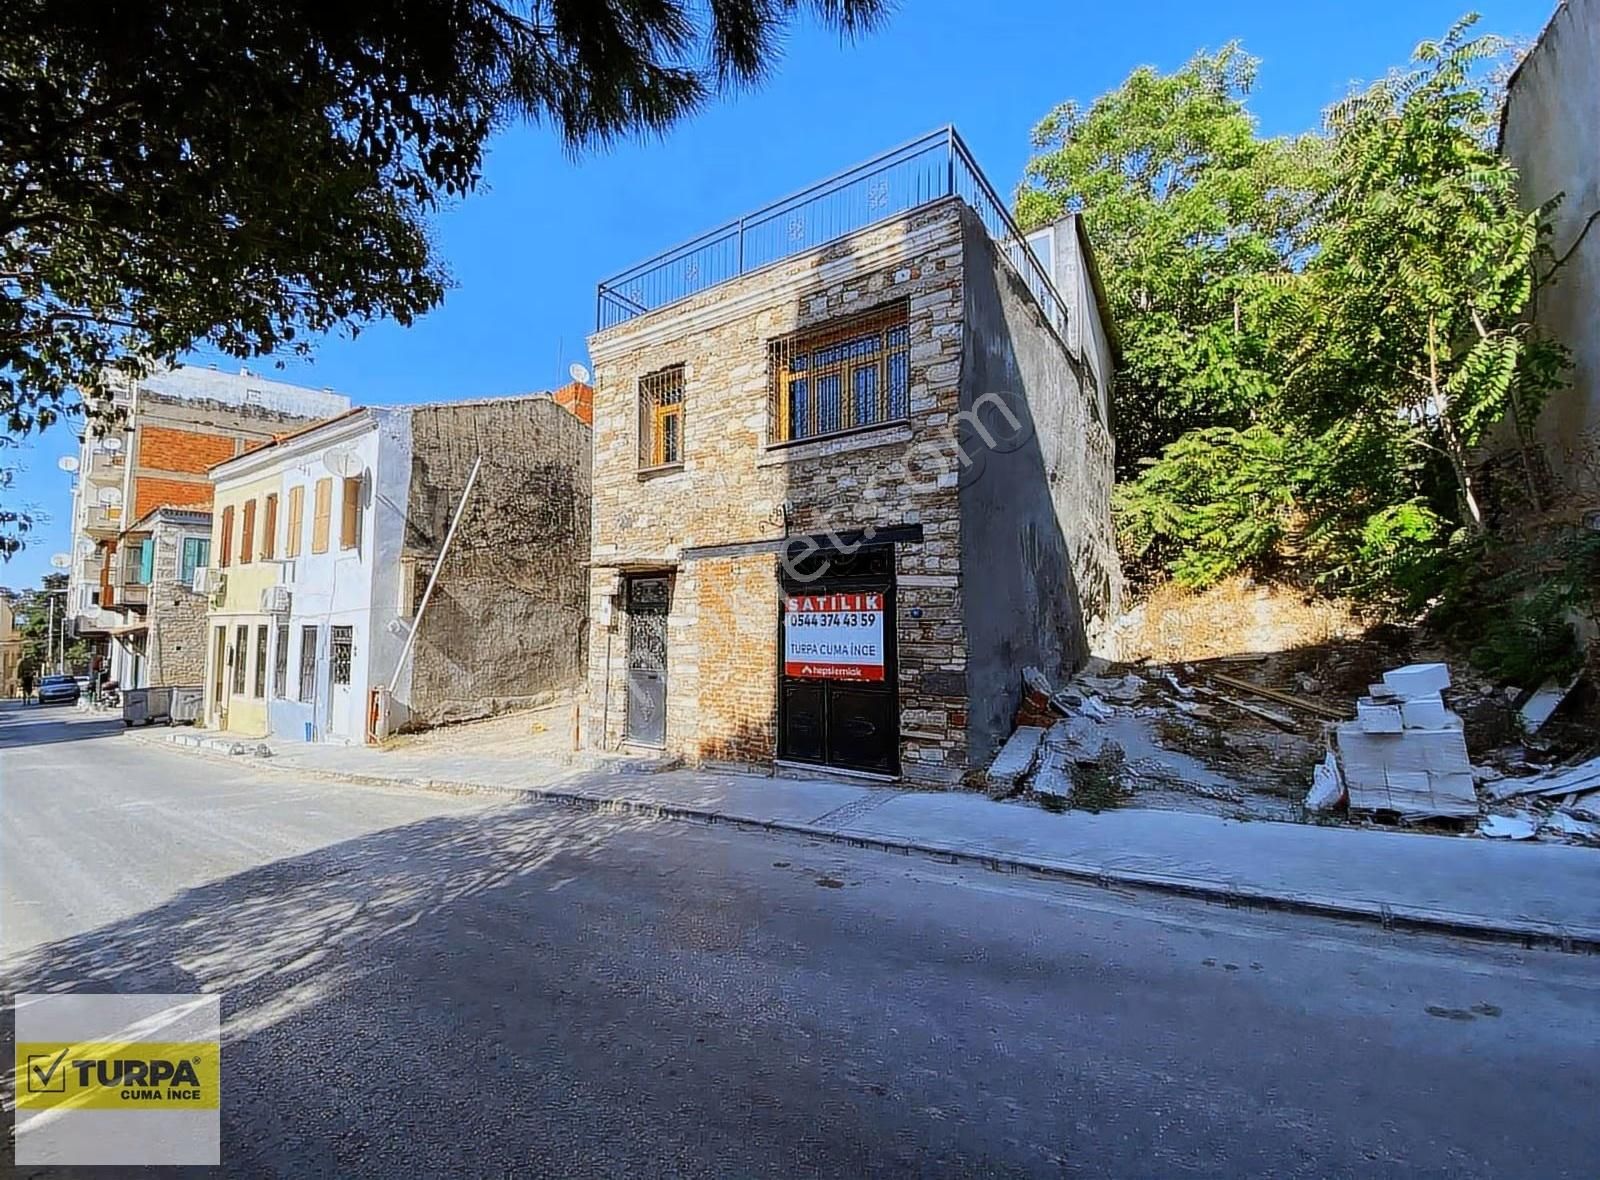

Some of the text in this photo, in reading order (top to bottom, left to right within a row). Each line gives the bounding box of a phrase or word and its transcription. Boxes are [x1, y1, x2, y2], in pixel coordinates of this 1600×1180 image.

[788, 595, 879, 611] SATILIK
[790, 613, 876, 627] 0544 374 43 59
[790, 642, 876, 657] TURPA CUMA İNCE
